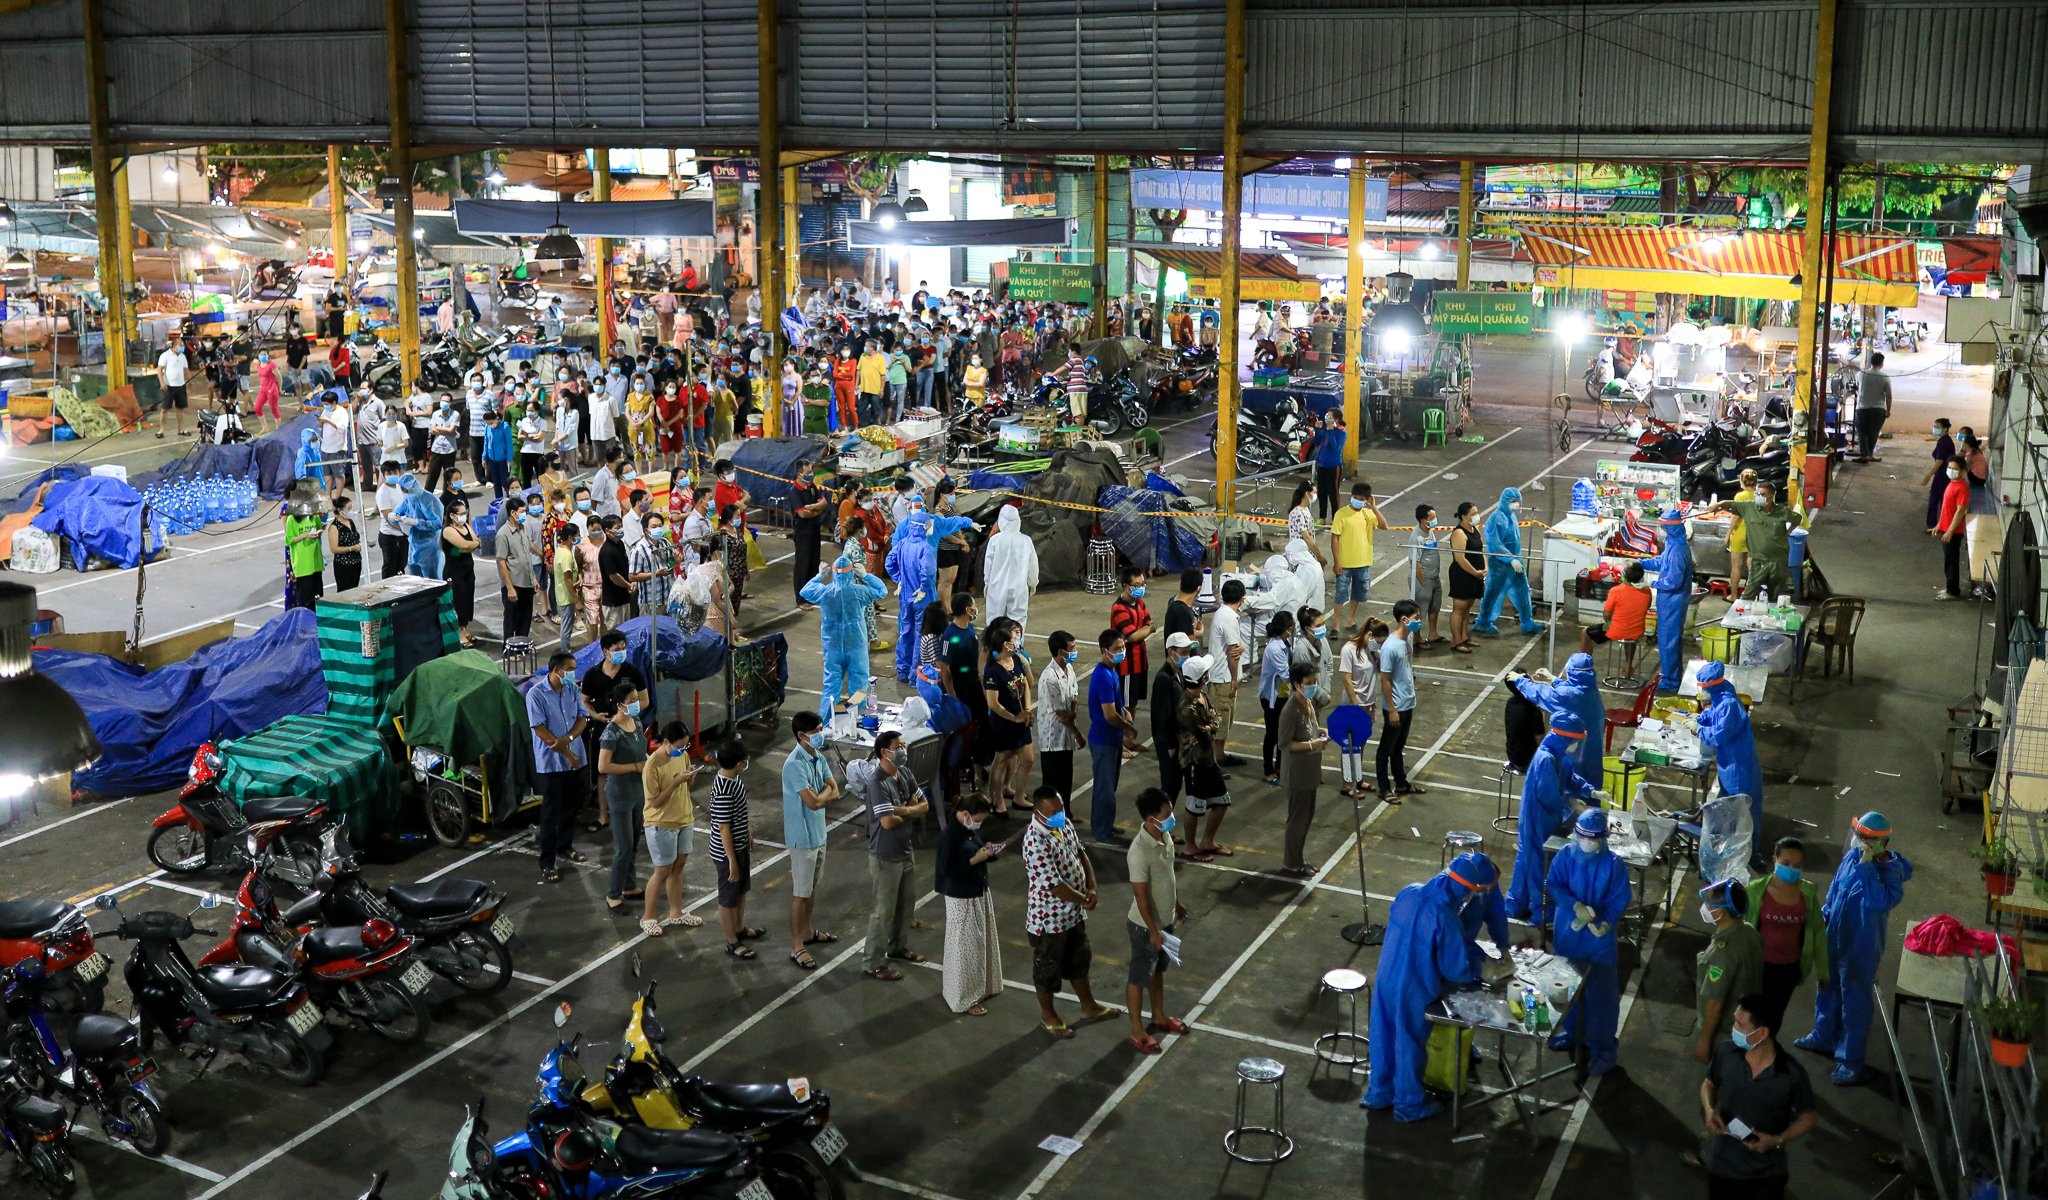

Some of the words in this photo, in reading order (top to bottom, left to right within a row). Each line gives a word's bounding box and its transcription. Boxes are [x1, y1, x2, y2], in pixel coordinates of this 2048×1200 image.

[1019, 267, 1037, 275] KHU
[1062, 268, 1080, 277] KHU
[1009, 276, 1032, 286] VÀNG
[1032, 279, 1049, 288] BẠC
[1014, 288, 1025, 297] ĐÁ
[1445, 302, 1466, 311] KHU
[1495, 303, 1516, 311] KHU
[1433, 314, 1448, 323] MỸ
[1514, 314, 1529, 324] ÁO
[404, 964, 423, 983] 85-B1
[297, 1012, 319, 1034] 7311
